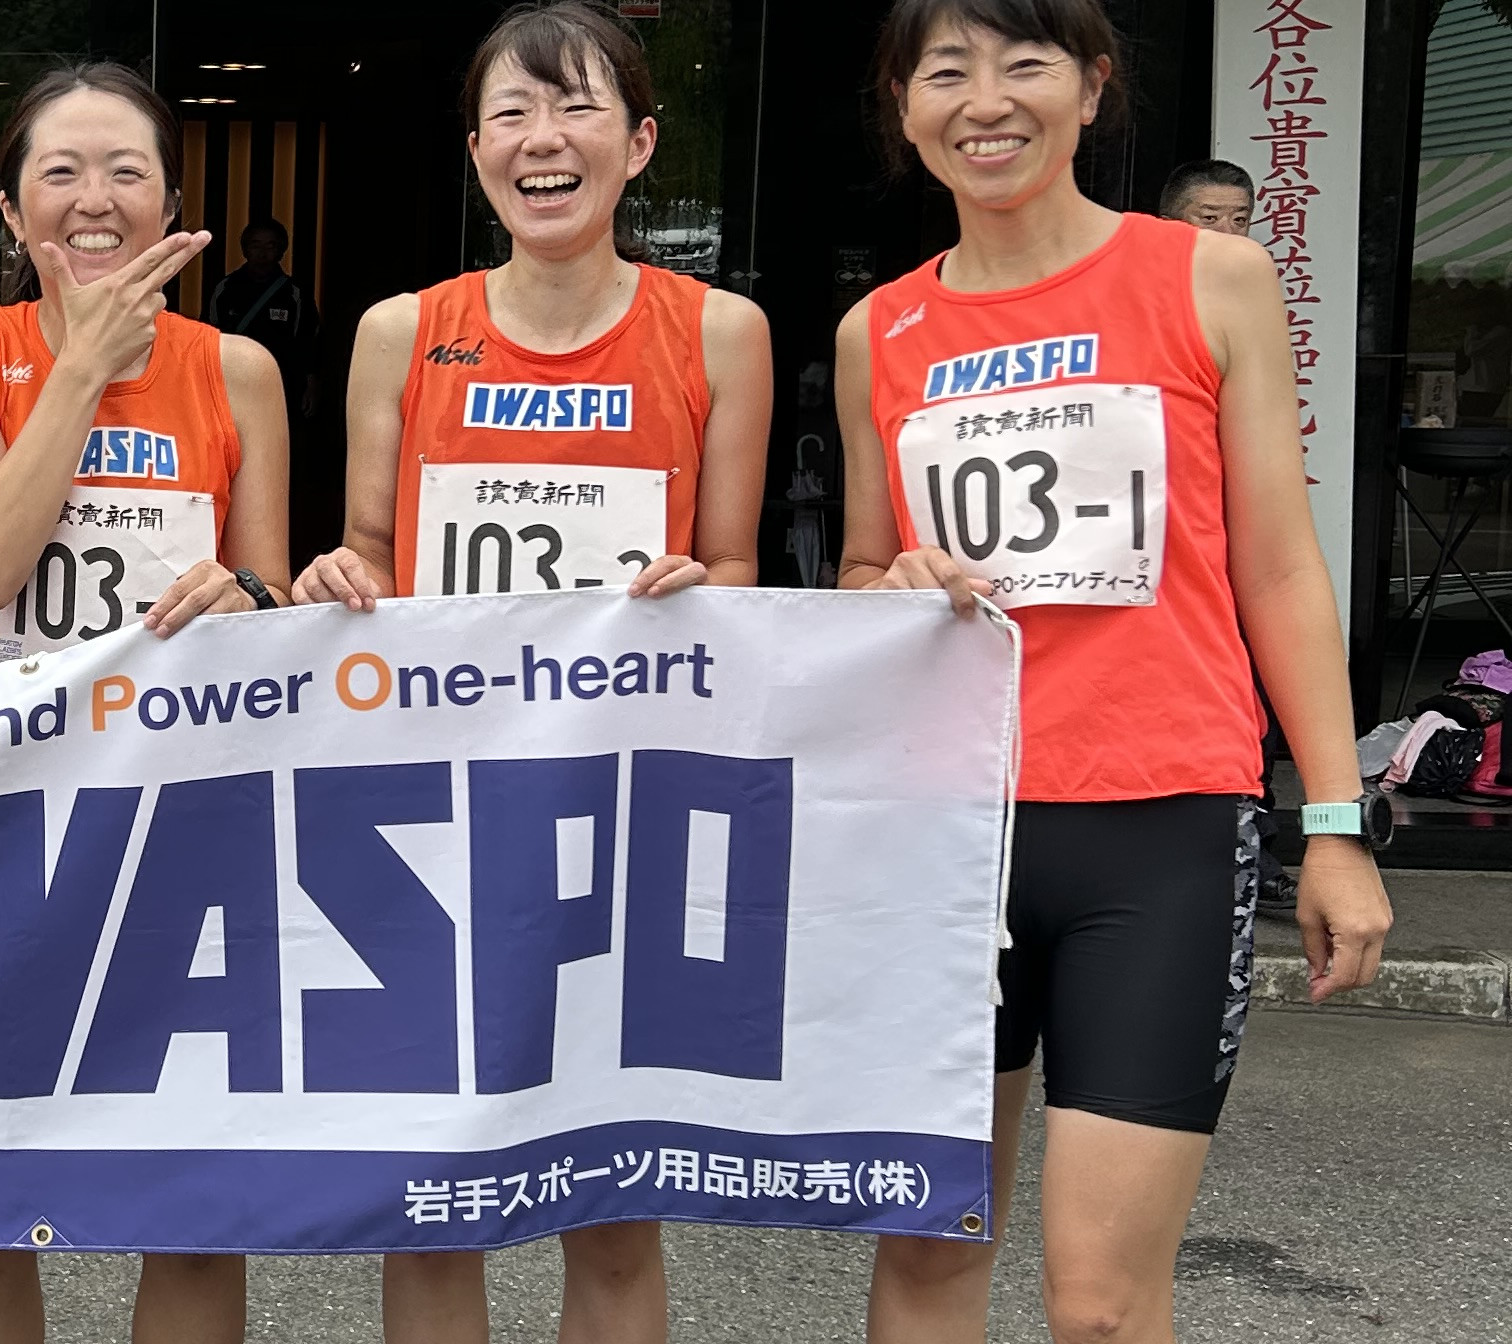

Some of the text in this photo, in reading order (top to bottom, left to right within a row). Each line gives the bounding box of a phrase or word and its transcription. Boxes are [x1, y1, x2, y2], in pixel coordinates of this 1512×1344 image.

[925, 336, 1096, 402] IWASPO
[468, 385, 629, 429] IWASPO
[77, 428, 177, 479] ASPO
[926, 450, 1145, 561] 103-1
[90, 670, 314, 733] Power
[334, 642, 715, 713] One-heart
[404, 1147, 932, 1225] 岩手スポーツ用品販売(株)
